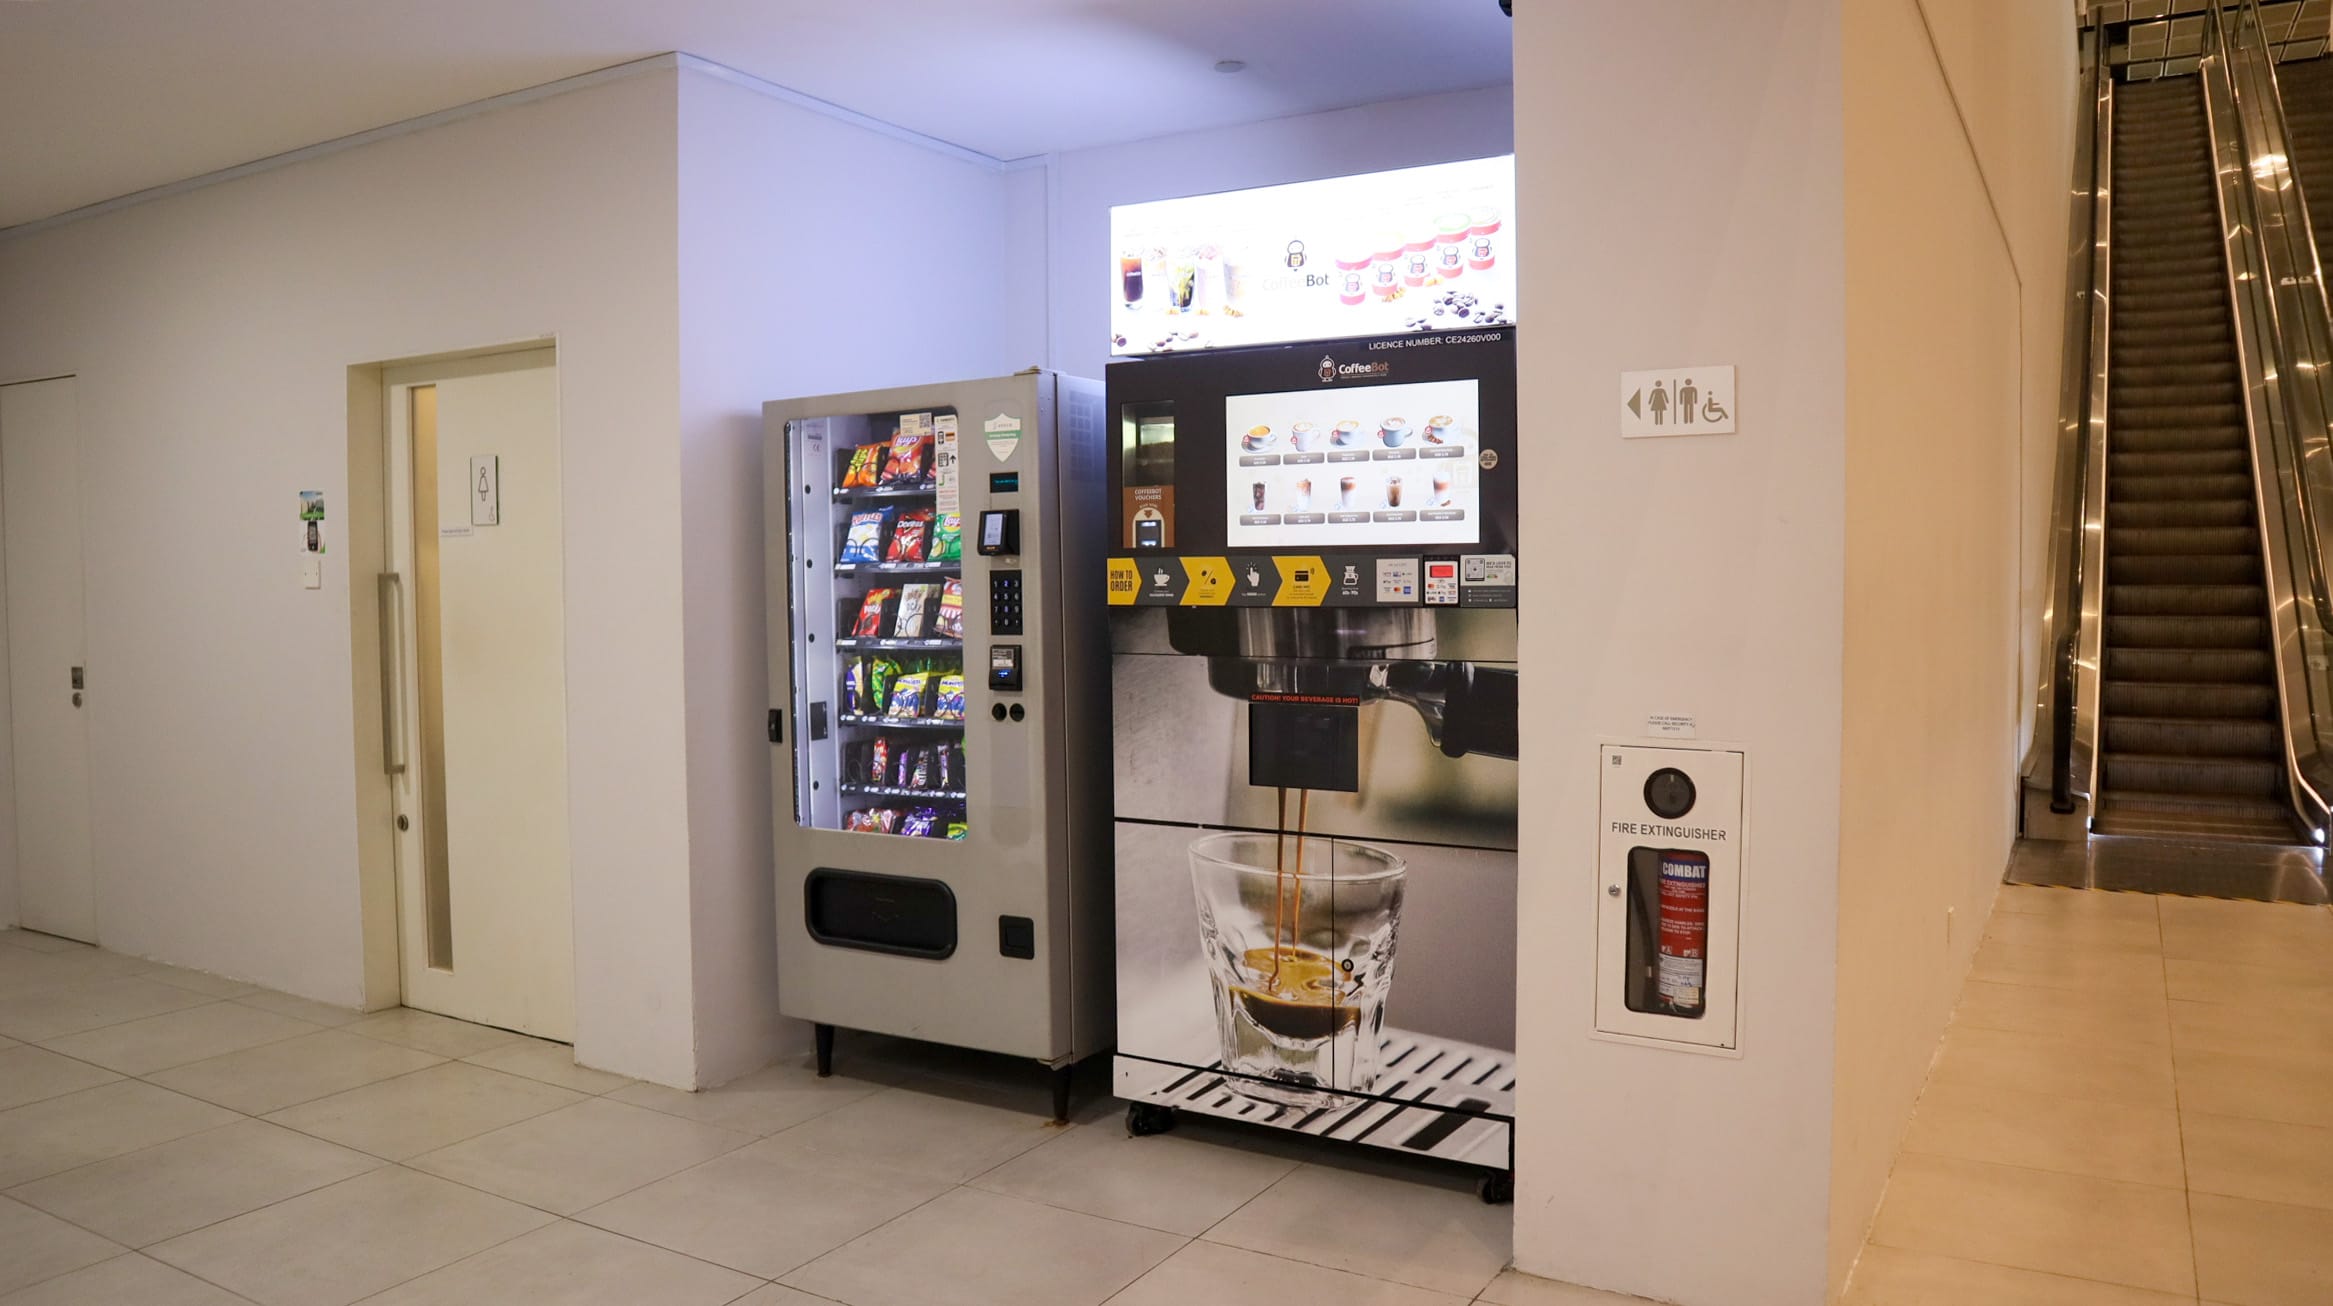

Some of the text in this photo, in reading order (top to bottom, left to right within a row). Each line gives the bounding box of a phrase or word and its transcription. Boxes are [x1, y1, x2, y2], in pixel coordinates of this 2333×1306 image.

[1369, 340, 1404, 350] LICENCE
[1405, 337, 1444, 347] NUMBER:
[1338, 362, 1389, 374] CoffeeBot
[1110, 570, 1133, 580] HOW TO
[1110, 580, 1133, 592] ORDER
[1300, 695, 1334, 703] BEVERAGE
[1611, 822, 1727, 841] FIRE EXTINGUISHER
[1663, 862, 1707, 878] COMBAT
